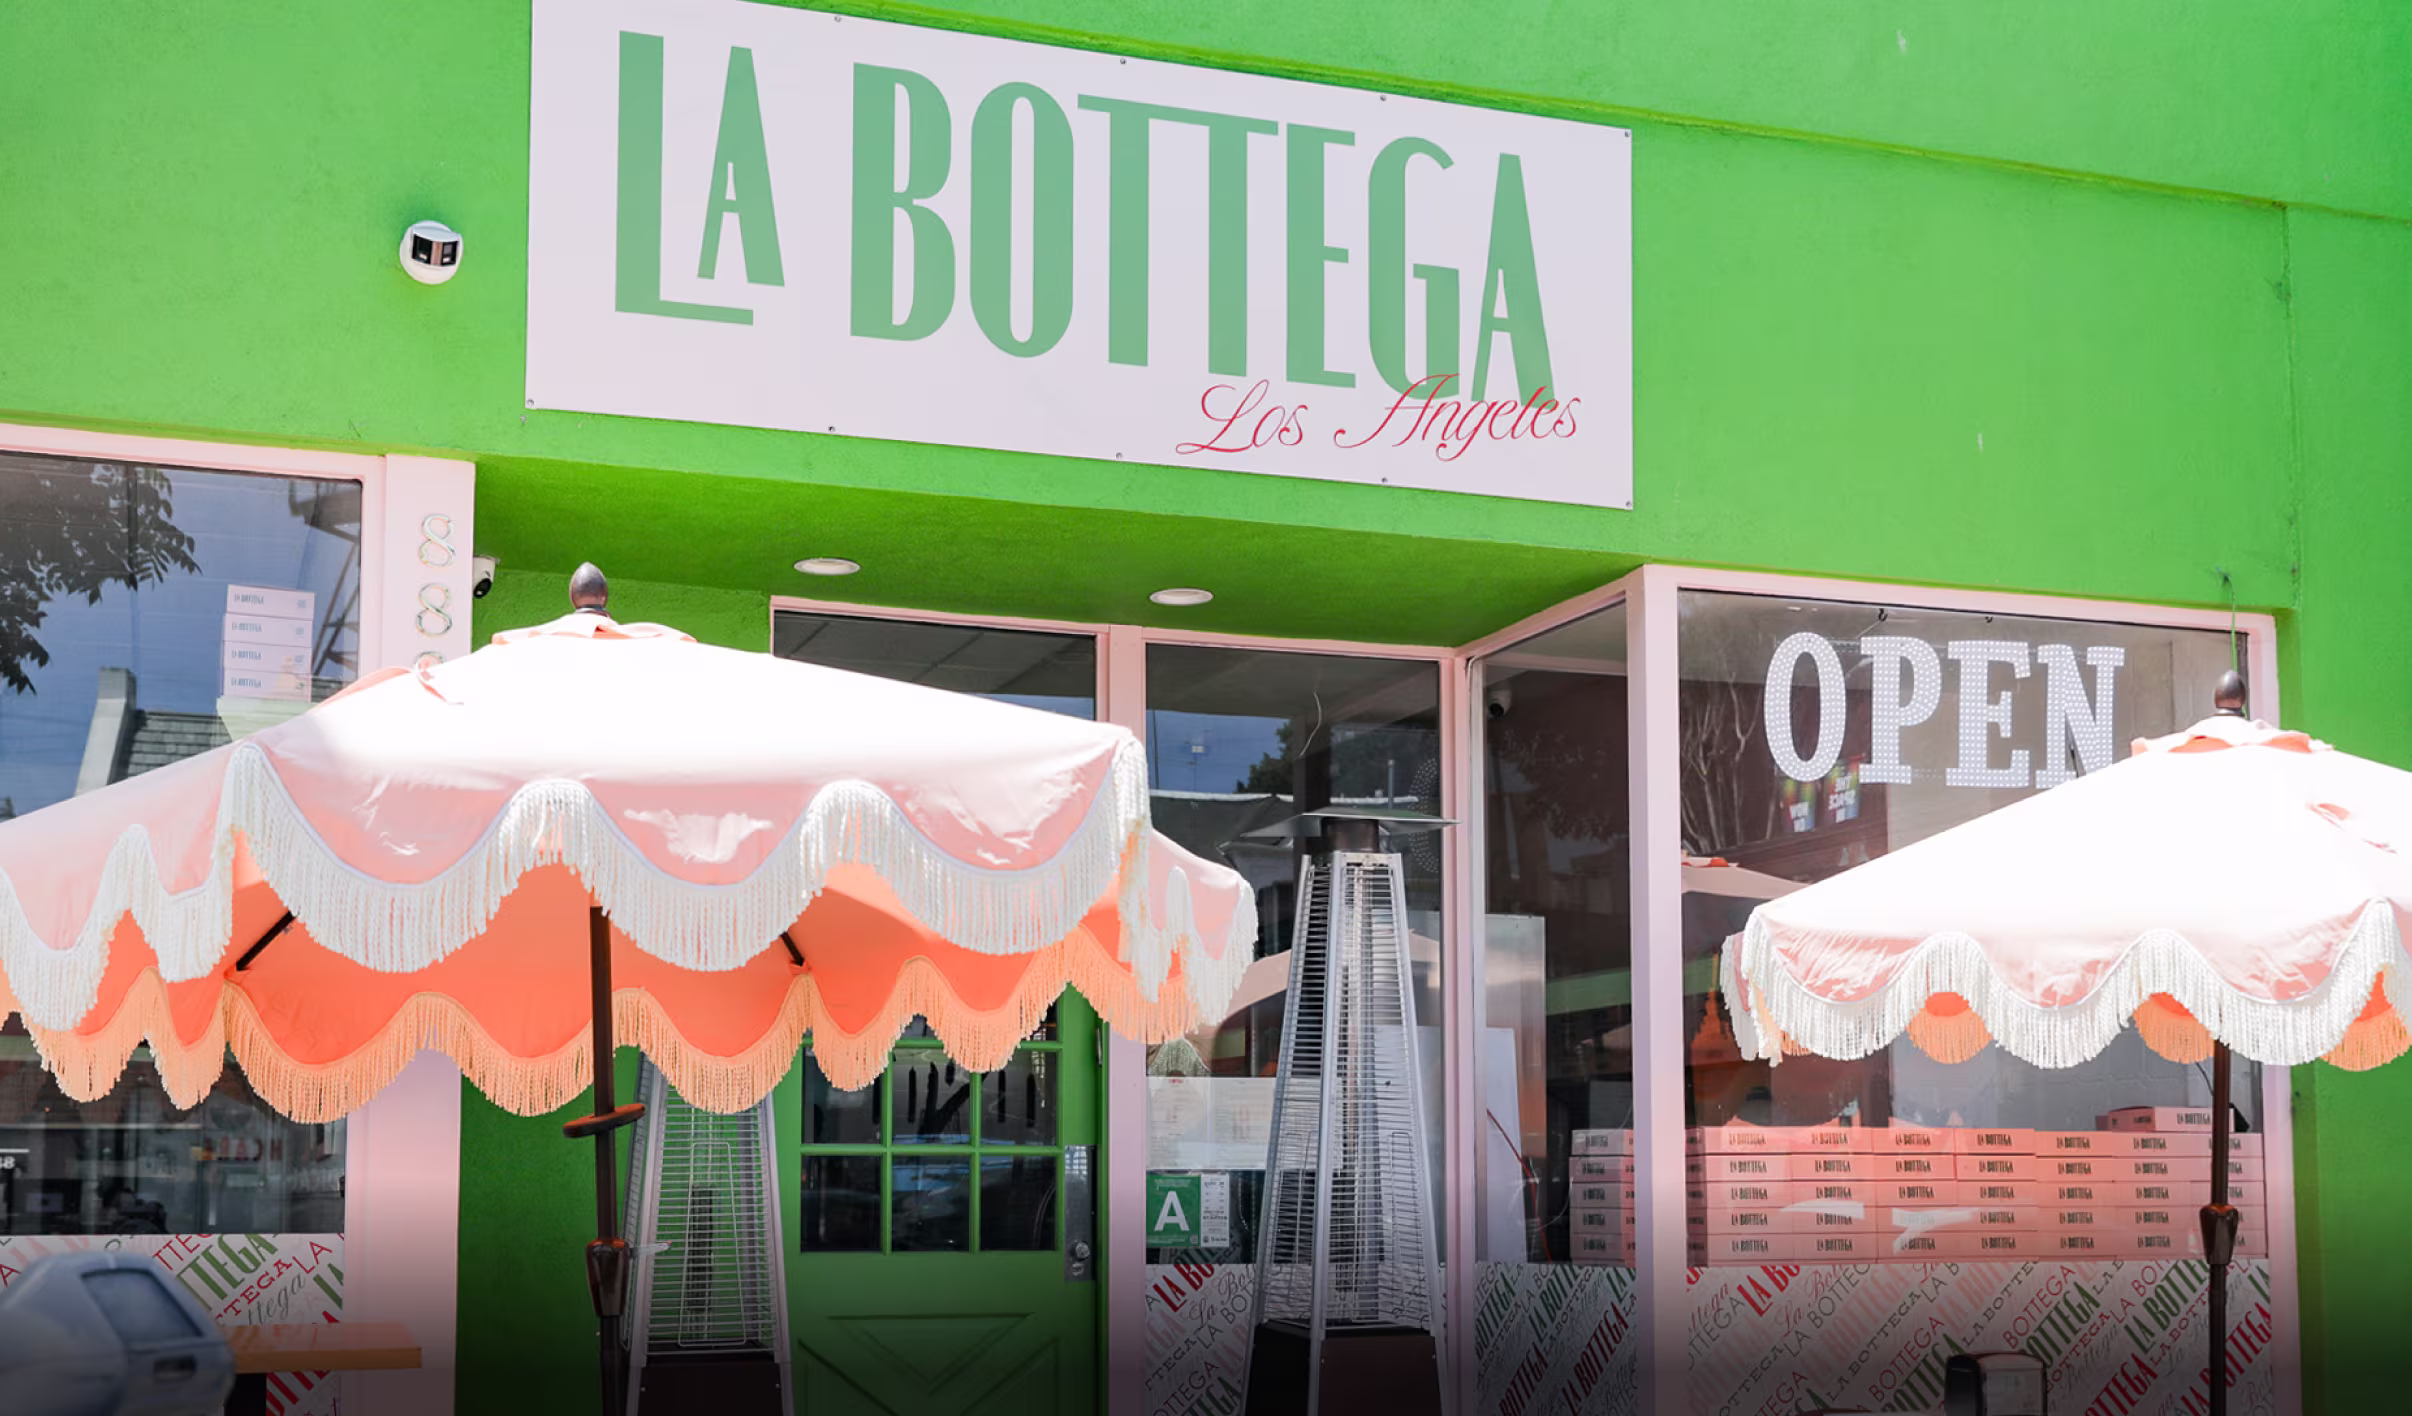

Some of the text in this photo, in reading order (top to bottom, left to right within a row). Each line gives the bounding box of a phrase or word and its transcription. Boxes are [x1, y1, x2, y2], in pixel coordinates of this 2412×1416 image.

[614, 30, 1555, 409] LA BOTTEGA
[1175, 372, 1583, 463] Los Angeles
[1763, 631, 2125, 789] OPEN
[1153, 1190, 1190, 1232] A
[1152, 1275, 1187, 1312] LA
[1737, 1275, 1773, 1317] LA
[1920, 1276, 1948, 1303] LA
[2002, 1264, 2077, 1350] BOTTEGA
[2024, 1281, 2101, 1369] OTTEGA
[1196, 1324, 1223, 1350] LA
[1574, 1301, 1629, 1398] BOTTEGA
[1783, 1330, 1812, 1357] LA
[1847, 1291, 1921, 1377] BOTTEGA
[1868, 1316, 1945, 1402] BOTTEGA
[2124, 1315, 2156, 1355] LA
